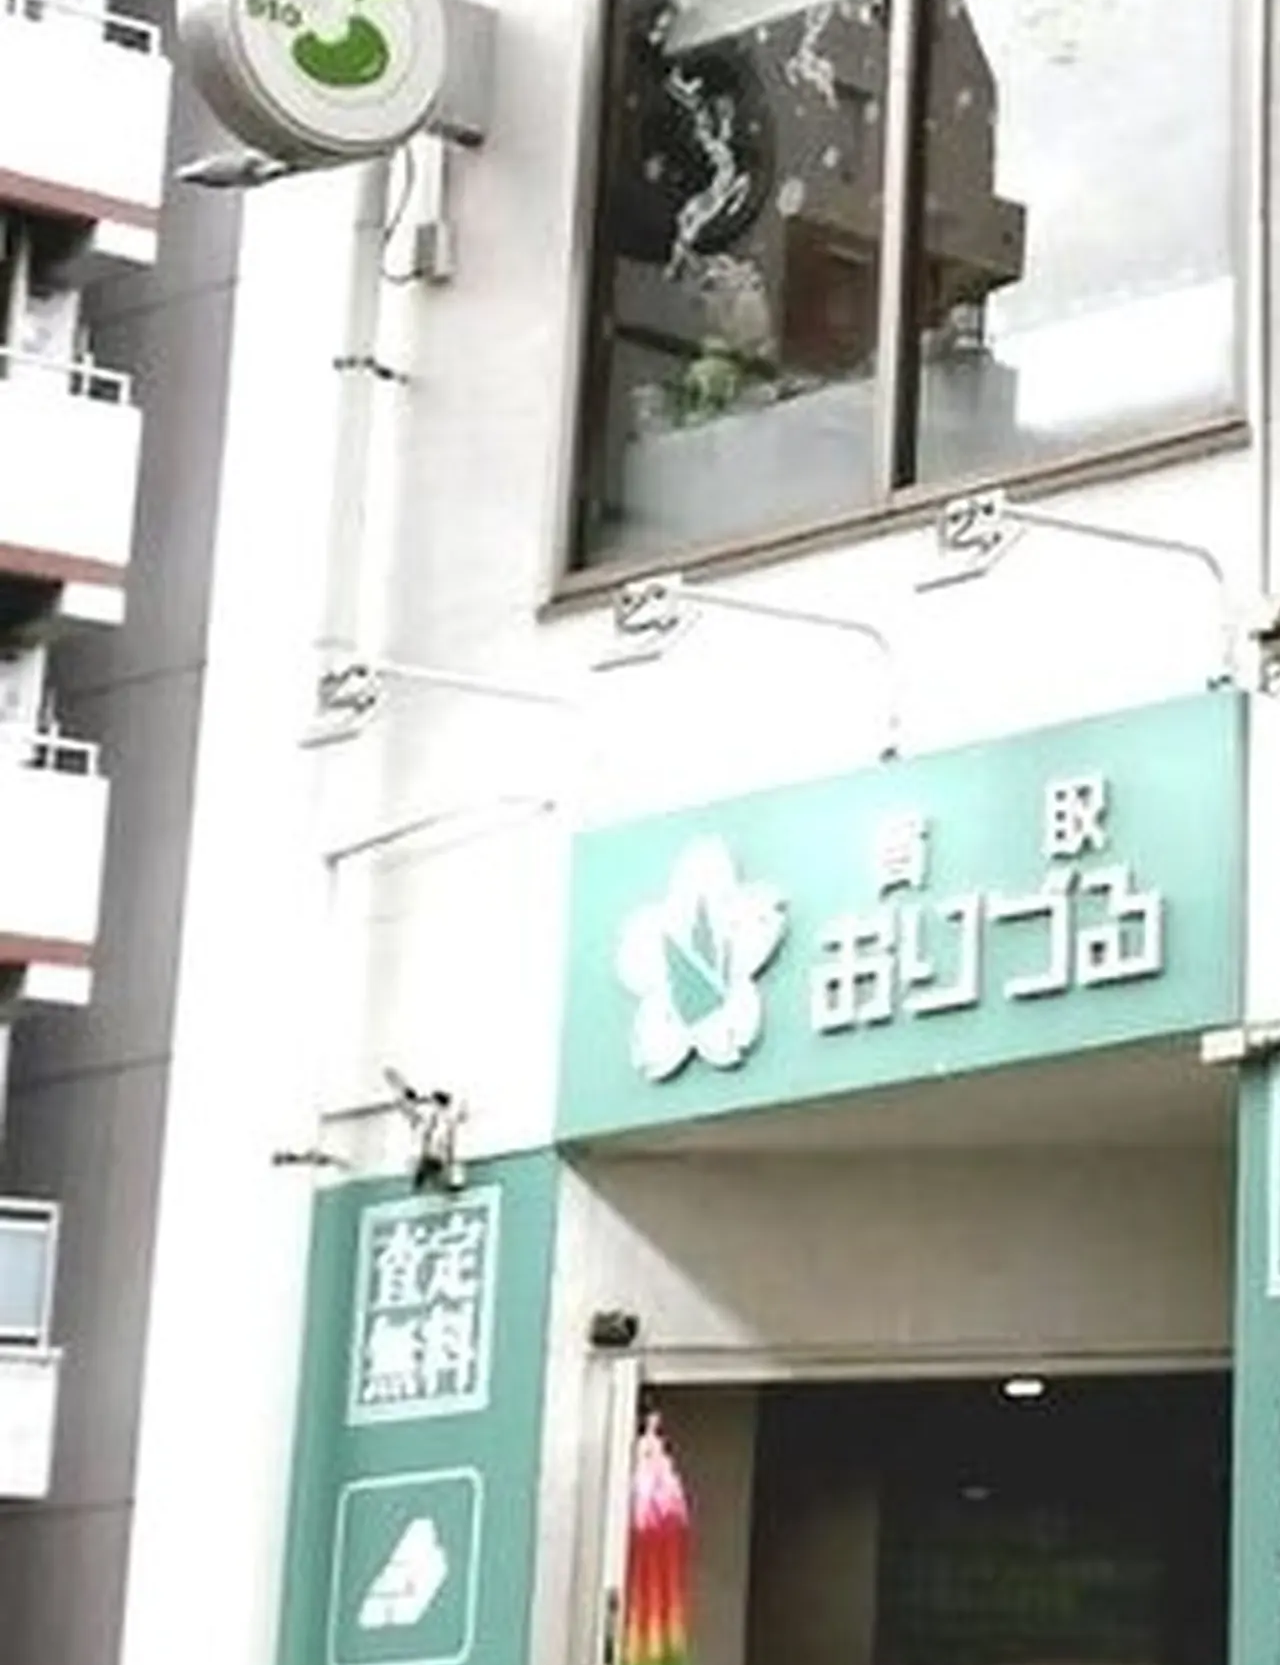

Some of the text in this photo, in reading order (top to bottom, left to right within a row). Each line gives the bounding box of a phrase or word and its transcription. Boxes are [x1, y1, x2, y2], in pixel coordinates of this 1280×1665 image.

[813, 866, 1164, 1034] おりづる
[373, 1210, 486, 1311] 査定
[362, 1300, 477, 1405] 無料
